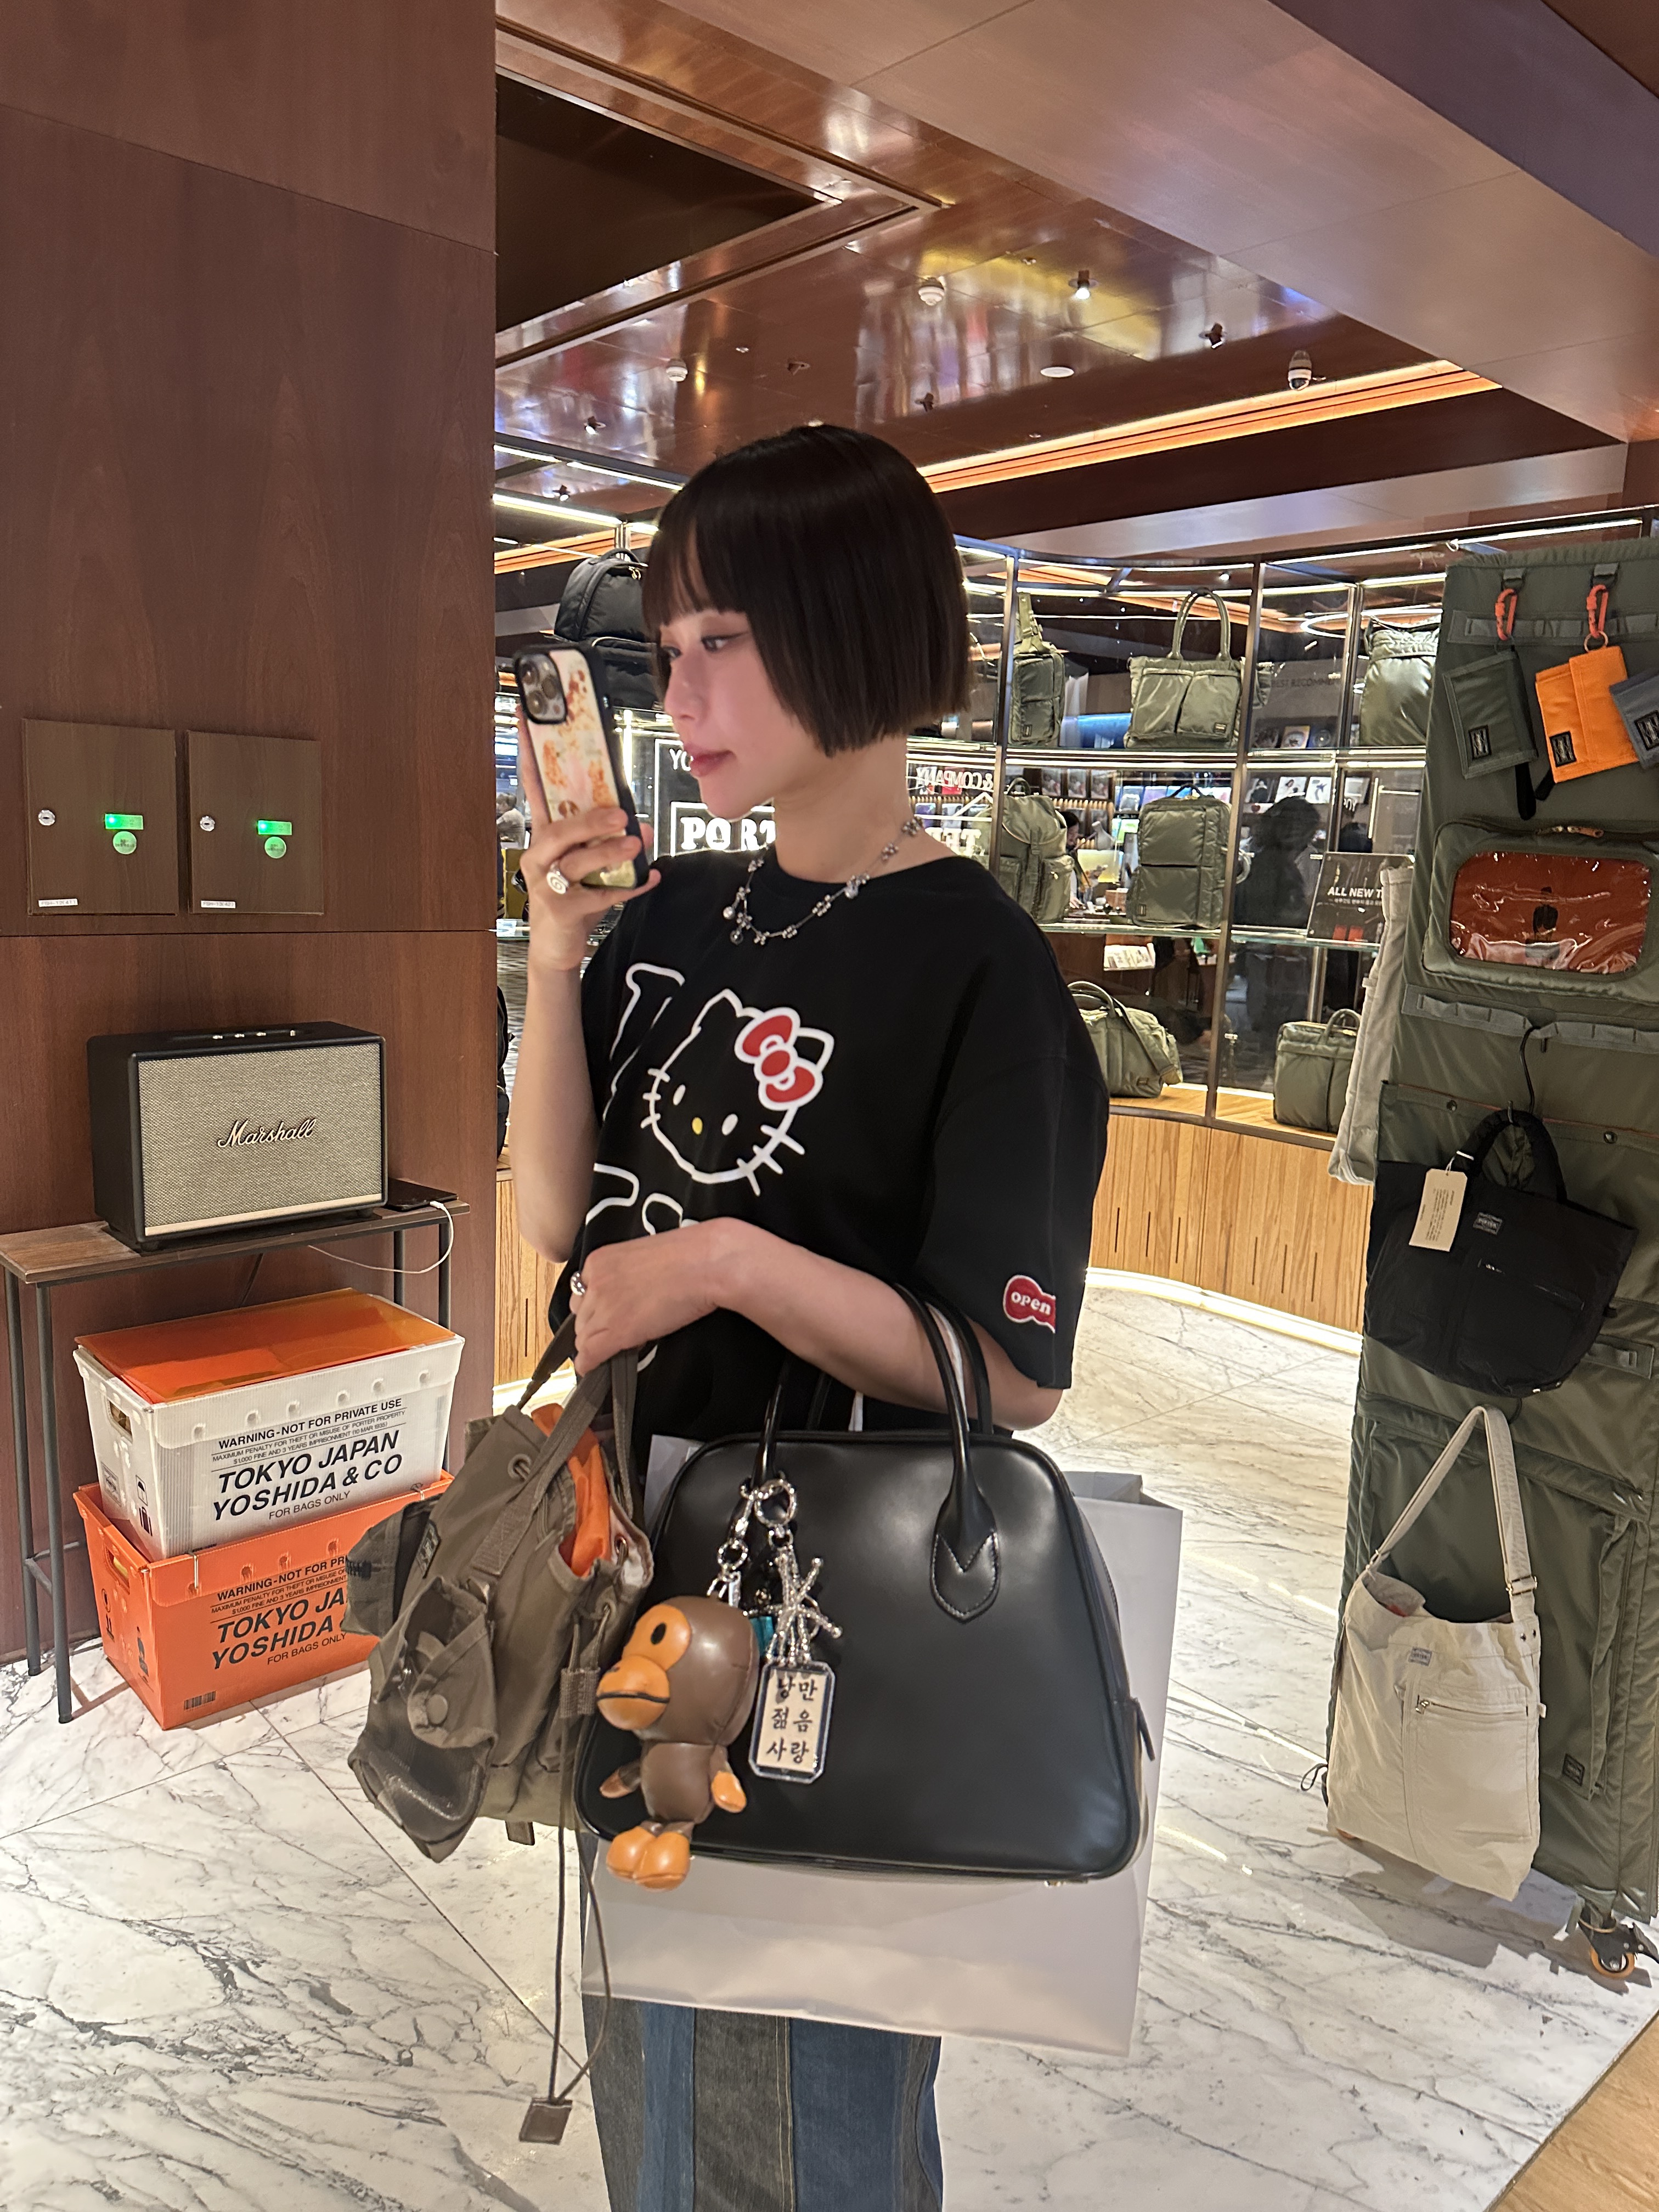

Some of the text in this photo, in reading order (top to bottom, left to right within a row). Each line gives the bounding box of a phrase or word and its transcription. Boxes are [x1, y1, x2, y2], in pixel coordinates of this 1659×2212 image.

[1328, 887, 1383, 898] ALL NEW T
[217, 1119, 317, 1148] Marshall
[1011, 1291, 1052, 1316] open
[308, 1416, 331, 1429] FOR
[335, 1404, 377, 1423] PRIVATE
[381, 1398, 402, 1410] USE
[212, 1450, 243, 1462] MAXIMUM
[245, 1443, 273, 1454] PENALTY
[274, 1440, 287, 1448] FOR
[289, 1435, 307, 1444] THEFT
[319, 1426, 341, 1436] MISUSE
[342, 1423, 352, 1431] OF
[352, 1418, 375, 1428] PORTER
[376, 1410, 405, 1422] PROPERTY
[254, 1451, 267, 1460] FINE
[288, 1442, 307, 1452] YEARS
[309, 1431, 351, 1446] IMPRISONMENT
[361, 1424, 374, 1433] MAR
[219, 1430, 399, 1493] TOKYO JAPAN
[213, 1454, 403, 1521] YOSHIDA & CO
[269, 1490, 351, 1520] FOR BAGS ONLY
[305, 1561, 327, 1576] FOR
[211, 1601, 242, 1613] MAXIMUM
[243, 1592, 270, 1604] PENALTY
[272, 1587, 285, 1596] FOR
[285, 1581, 304, 1591] THEFT
[315, 1571, 337, 1582] MISUSE
[285, 1588, 304, 1598] YEARS
[306, 1575, 346, 1592] IMPRISONMENT
[218, 1587, 347, 1644] TOKYO JA
[212, 1615, 333, 1669] YOSHIDA
[267, 1632, 347, 1666] FOR BAGS ONLY
[771, 1706, 813, 1733] 젊음
[766, 1736, 810, 1764] 사랑
